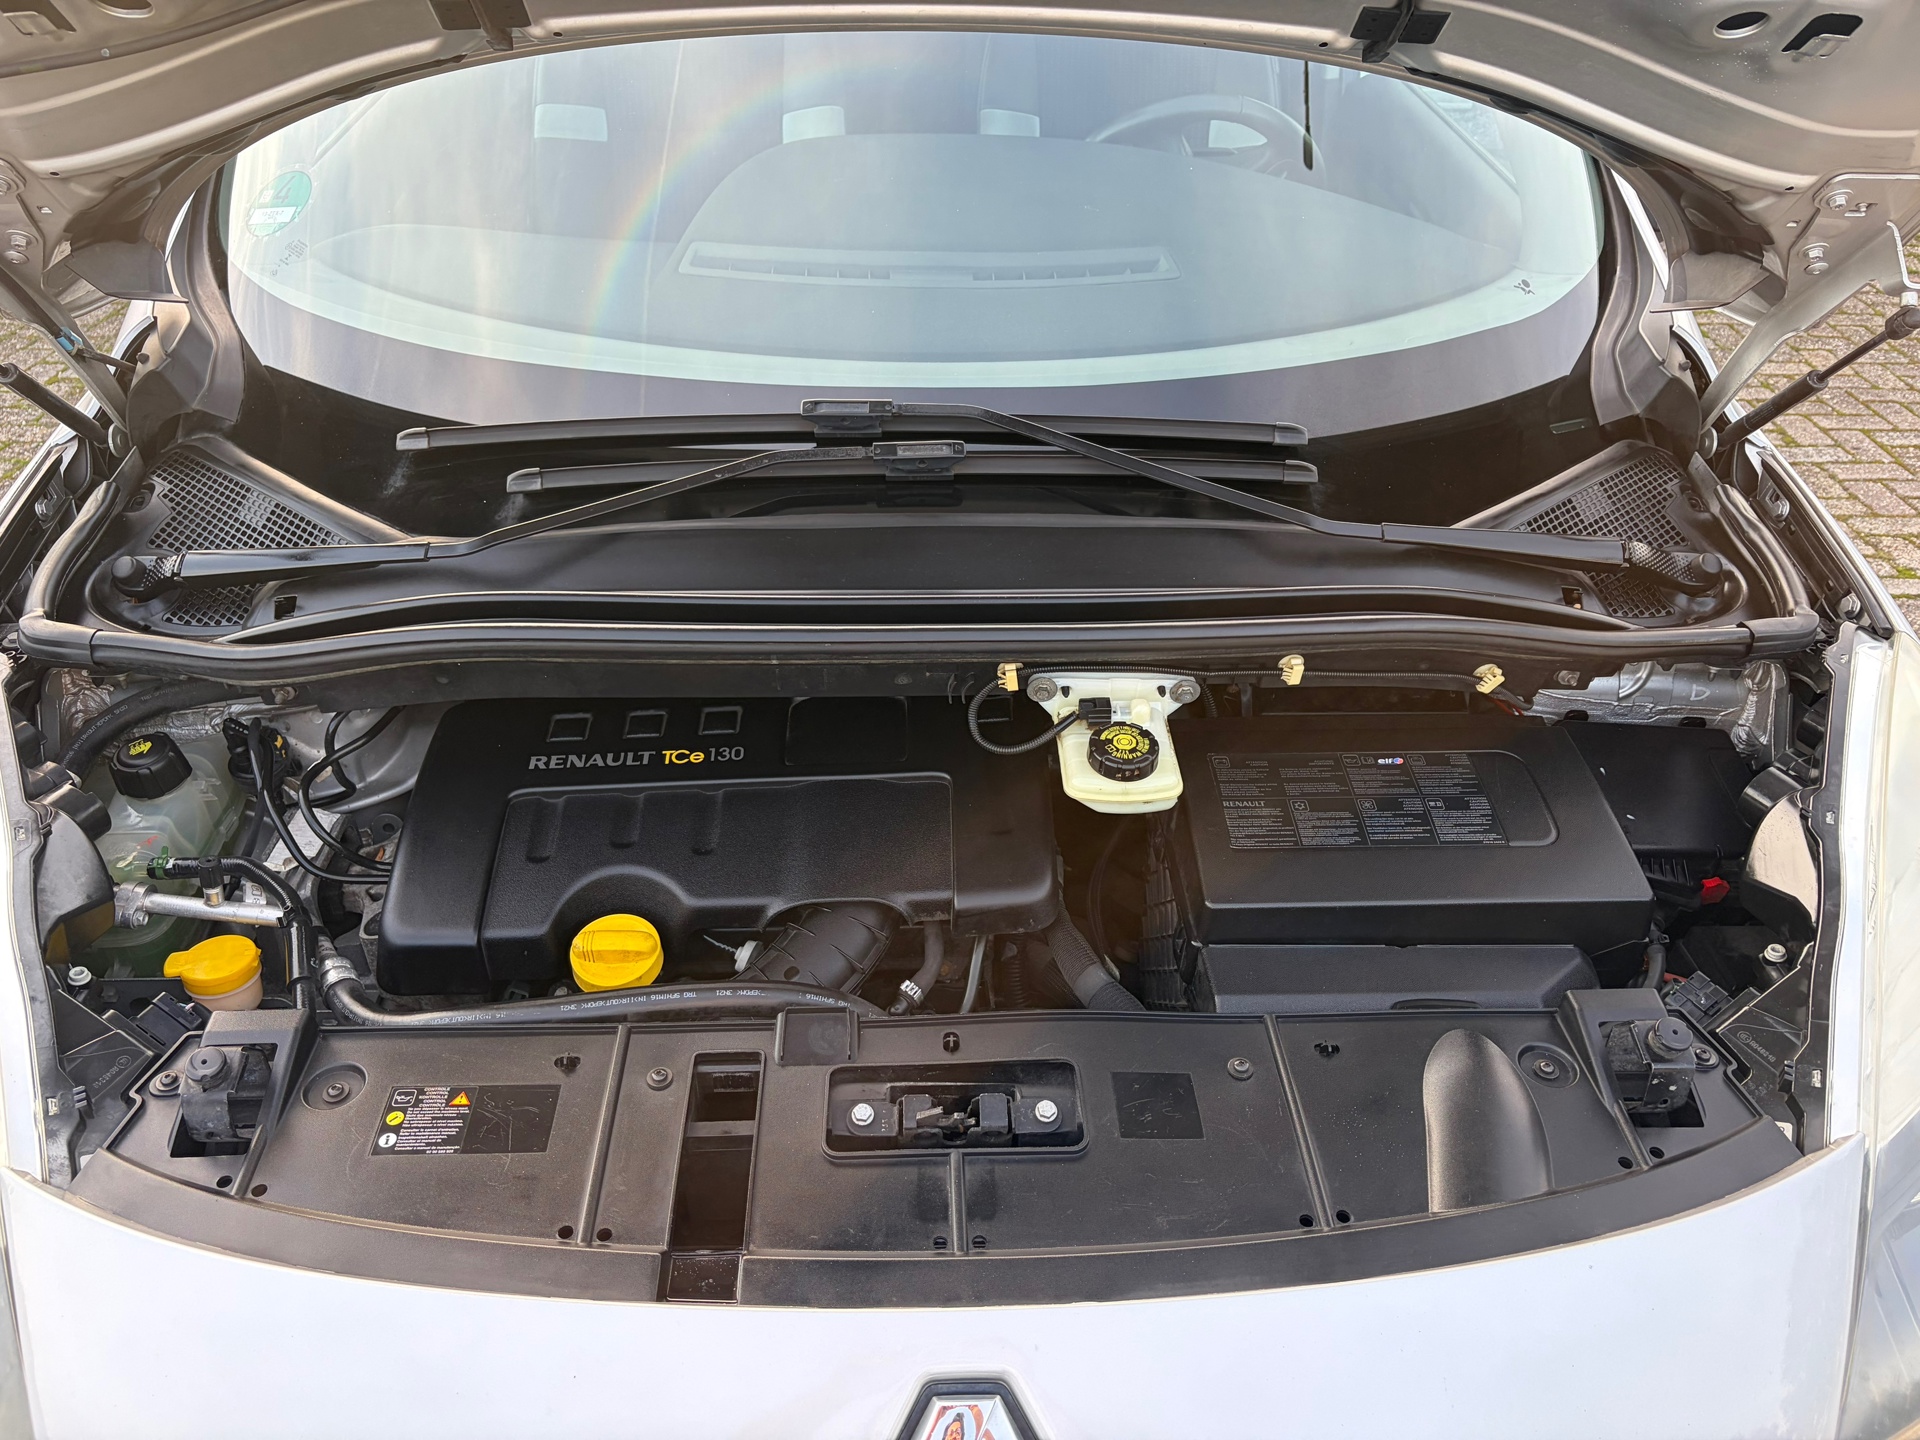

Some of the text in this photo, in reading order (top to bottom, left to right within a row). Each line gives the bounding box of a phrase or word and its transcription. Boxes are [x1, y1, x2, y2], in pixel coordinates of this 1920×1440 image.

[528, 746, 745, 770] RENAULT TCe 130
[1111, 750, 1143, 760] WARNING
[1377, 757, 1394, 765] elf
